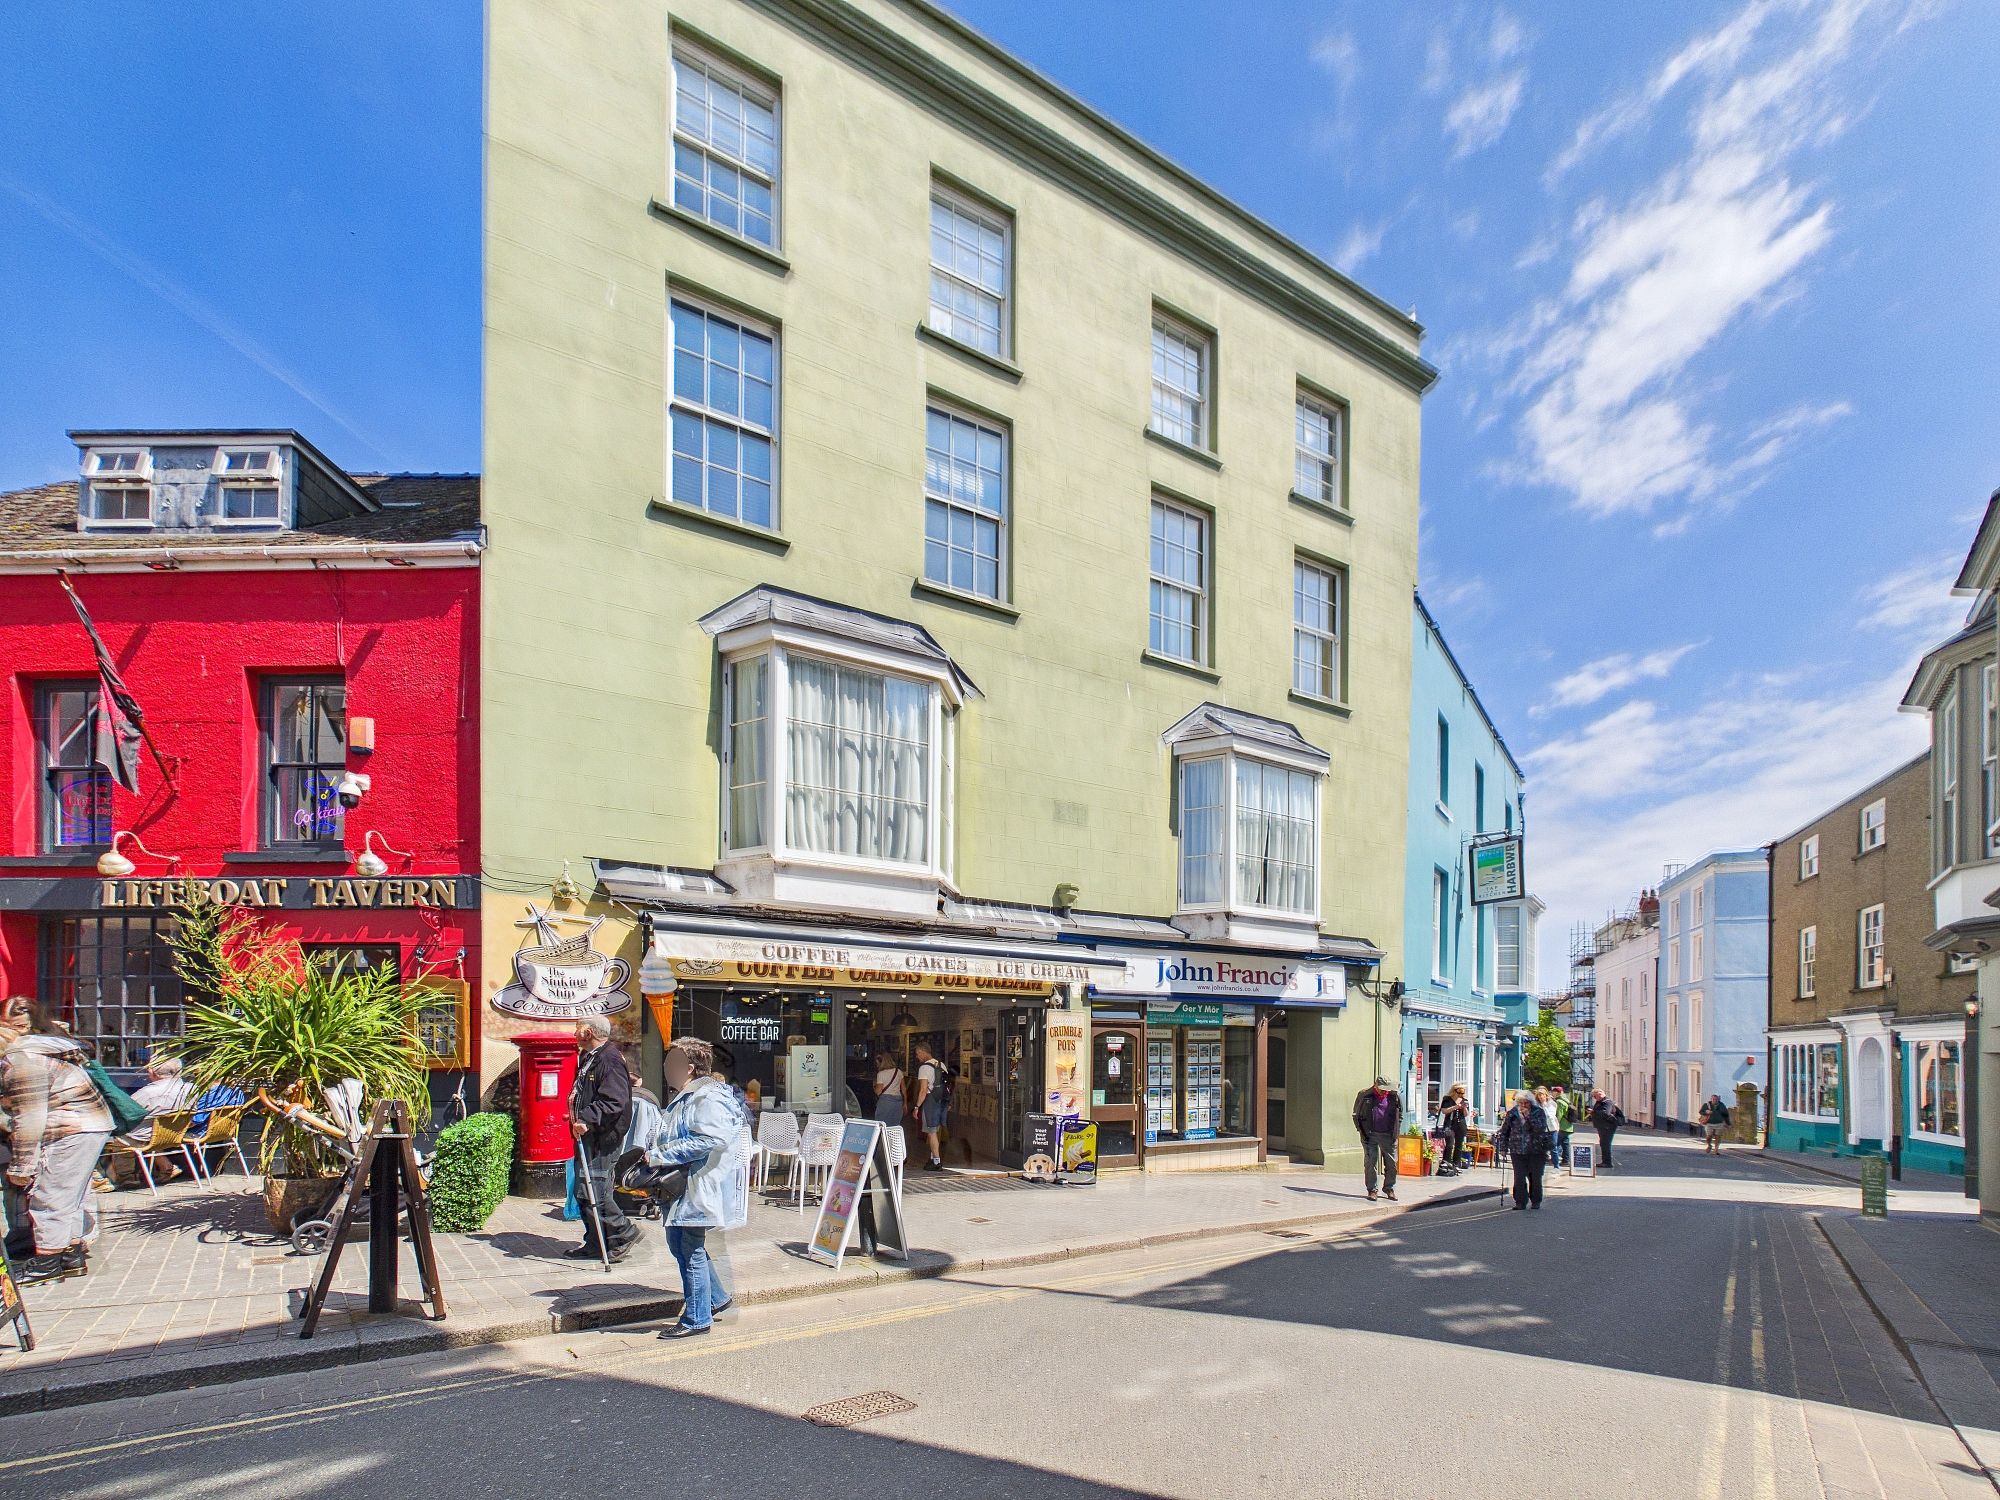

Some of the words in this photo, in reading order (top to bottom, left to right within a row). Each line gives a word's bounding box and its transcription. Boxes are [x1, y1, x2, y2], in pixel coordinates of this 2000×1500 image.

[1506, 843, 1517, 893] HARBWR
[101, 878, 287, 908] LIFEBOAT
[309, 878, 456, 908] TAVERN
[762, 942, 850, 966] COFFEE
[904, 952, 968, 973] CAKES
[548, 967, 566, 976] The
[737, 961, 835, 981] COFFEE
[996, 962, 1025, 977] ICE
[1030, 963, 1091, 982] CREAM
[1155, 958, 1214, 988] John
[1215, 961, 1298, 990] Francis
[541, 976, 588, 991] Sinking
[1196, 984, 1260, 993] www.johnfrancis.co.uk
[1314, 972, 1336, 998] JF
[547, 988, 576, 1002] Ship
[512, 1000, 571, 1017] COFFEE
[575, 1001, 610, 1016] SHOP
[1182, 1004, 1197, 1013] Ger
[1197, 1004, 1203, 1012] Y
[1204, 1005, 1220, 1013] Môr
[721, 1025, 758, 1041] COFFEE
[760, 1026, 779, 1041] BAR
[1049, 1025, 1083, 1038] CRUMBLE
[1057, 1039, 1076, 1051] POTS
